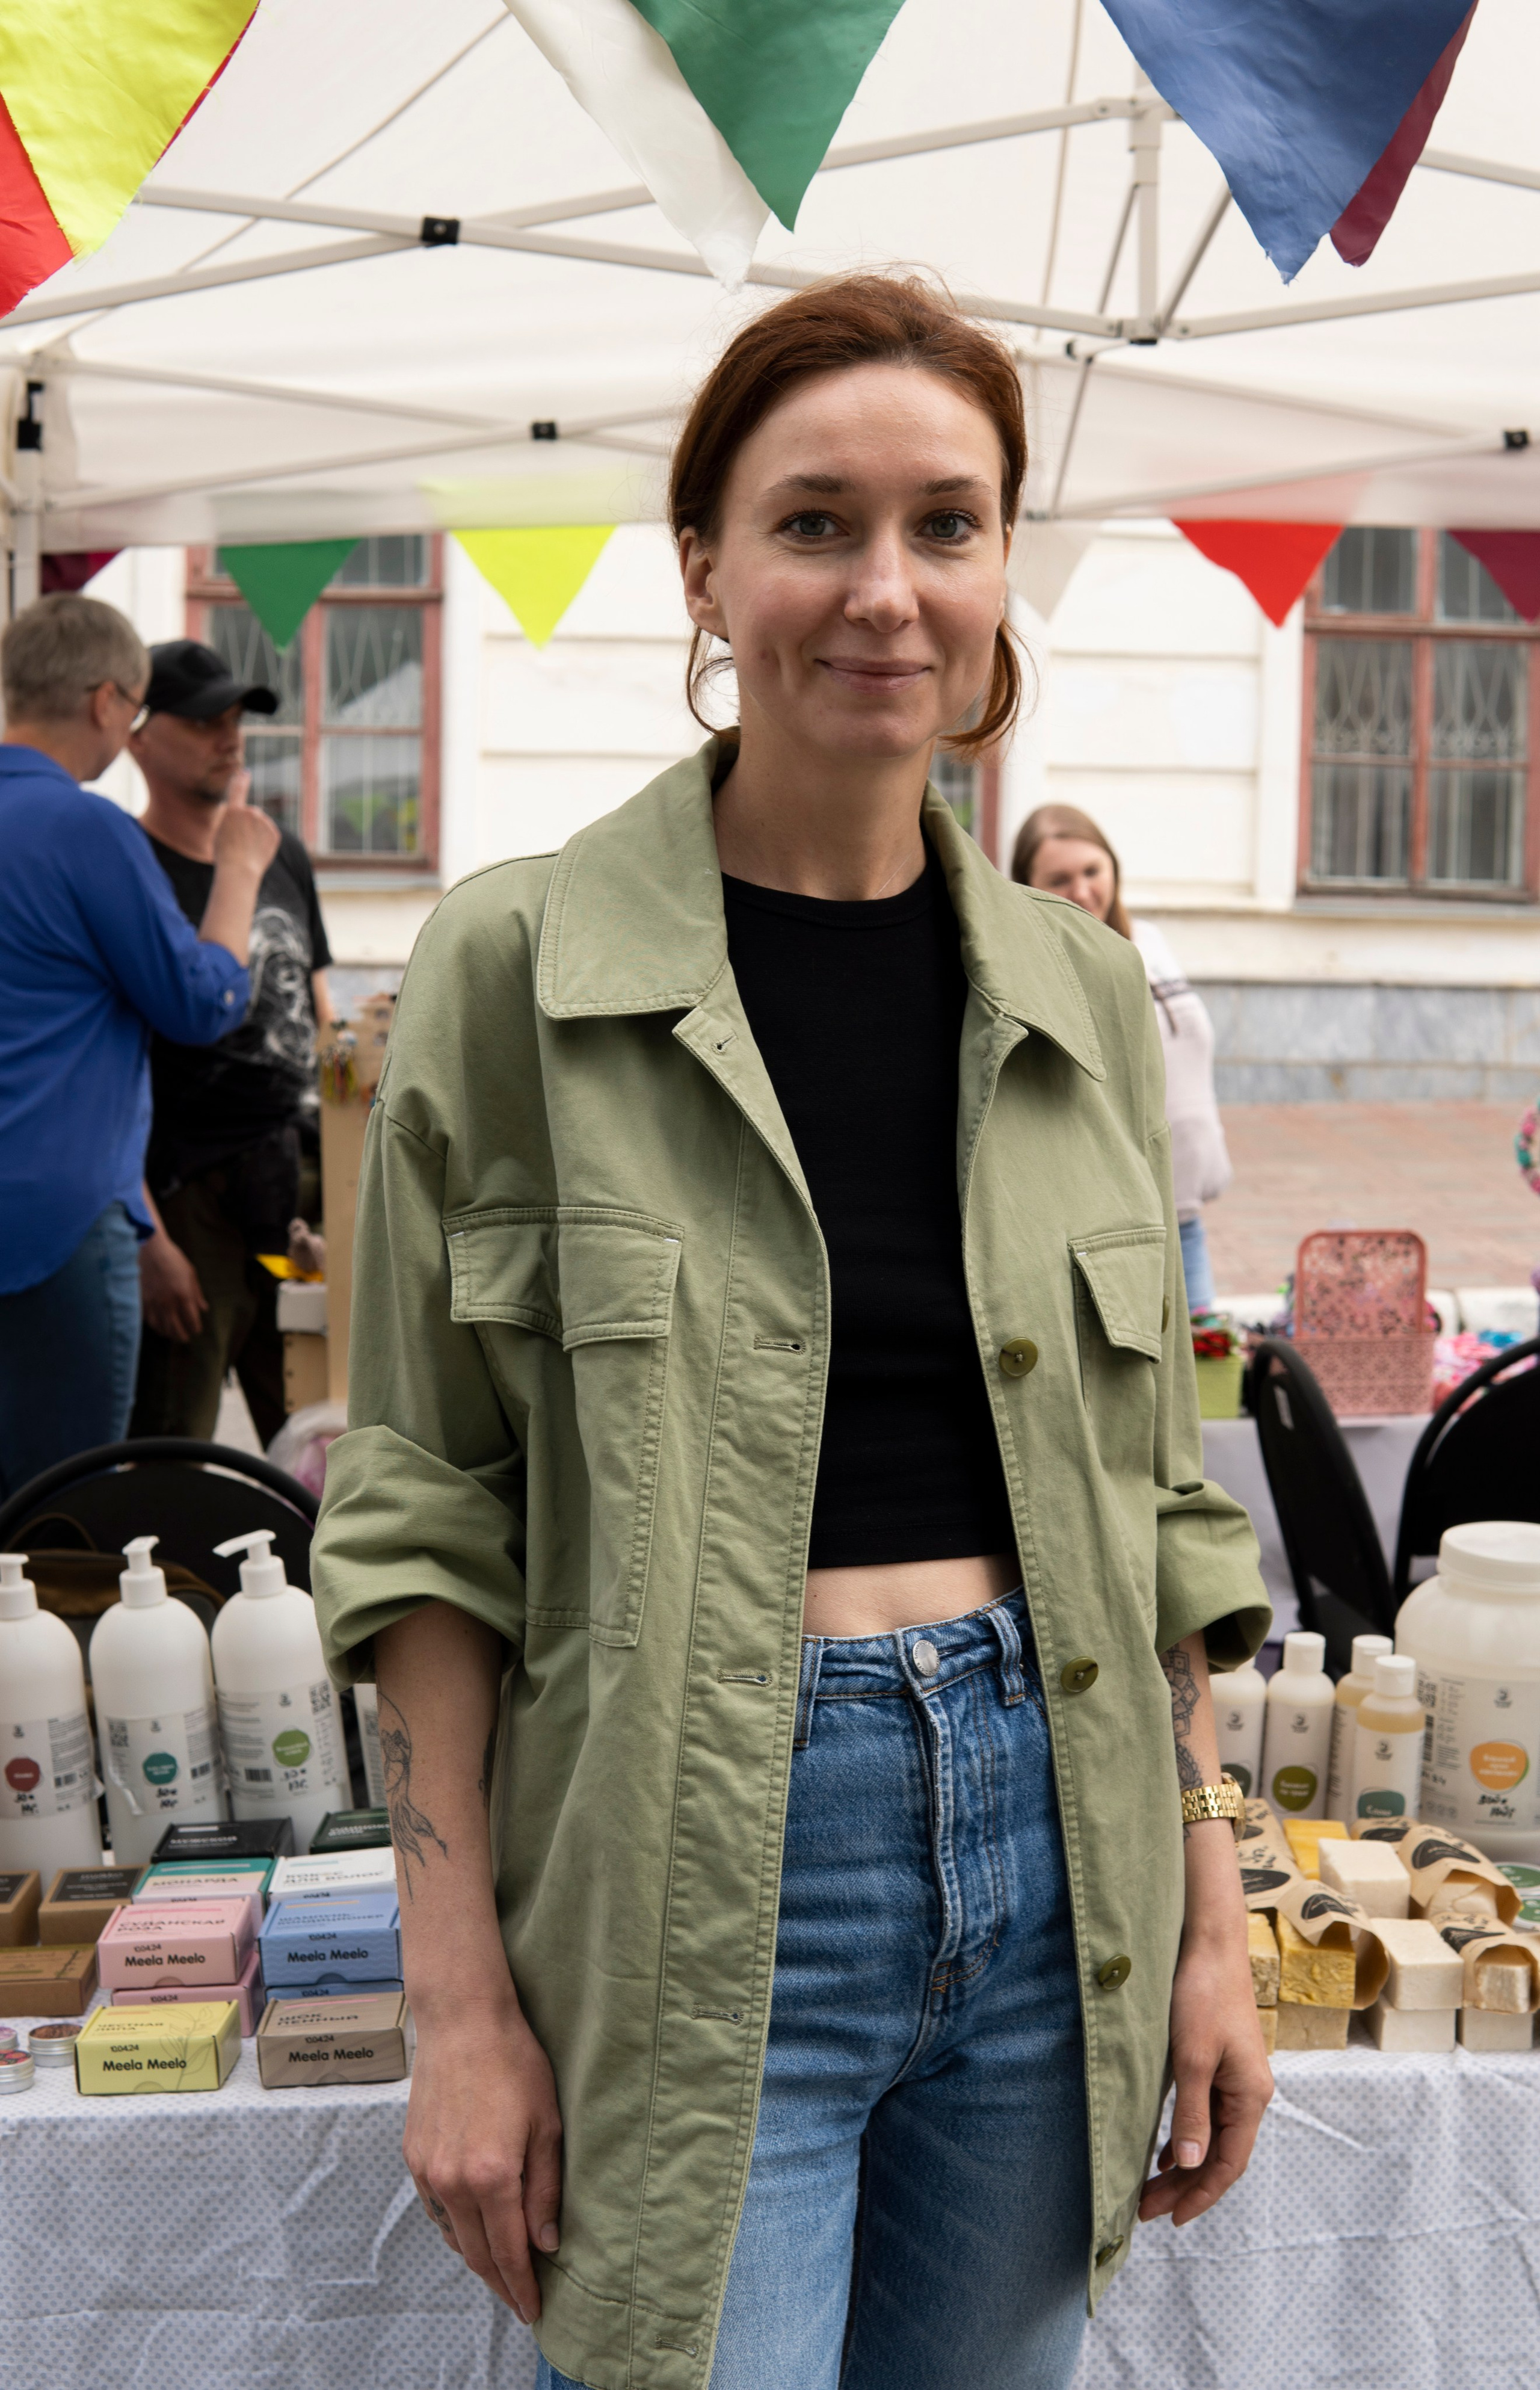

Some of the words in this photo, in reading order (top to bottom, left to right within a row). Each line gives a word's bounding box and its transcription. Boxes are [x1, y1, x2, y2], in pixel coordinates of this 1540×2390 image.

[125, 1956, 164, 1966] Meela
[167, 1953, 206, 1965] Meelo
[288, 1950, 327, 1963] Meela
[330, 1947, 369, 1960] Meelo
[277, 2015, 359, 2025] ПЕННЫЙ
[279, 2012, 322, 2022] ШОК
[288, 2049, 329, 2062] Meela
[333, 2047, 374, 2060] Meelo
[103, 2059, 143, 2071] Meela
[147, 2057, 187, 2070] Meelo
